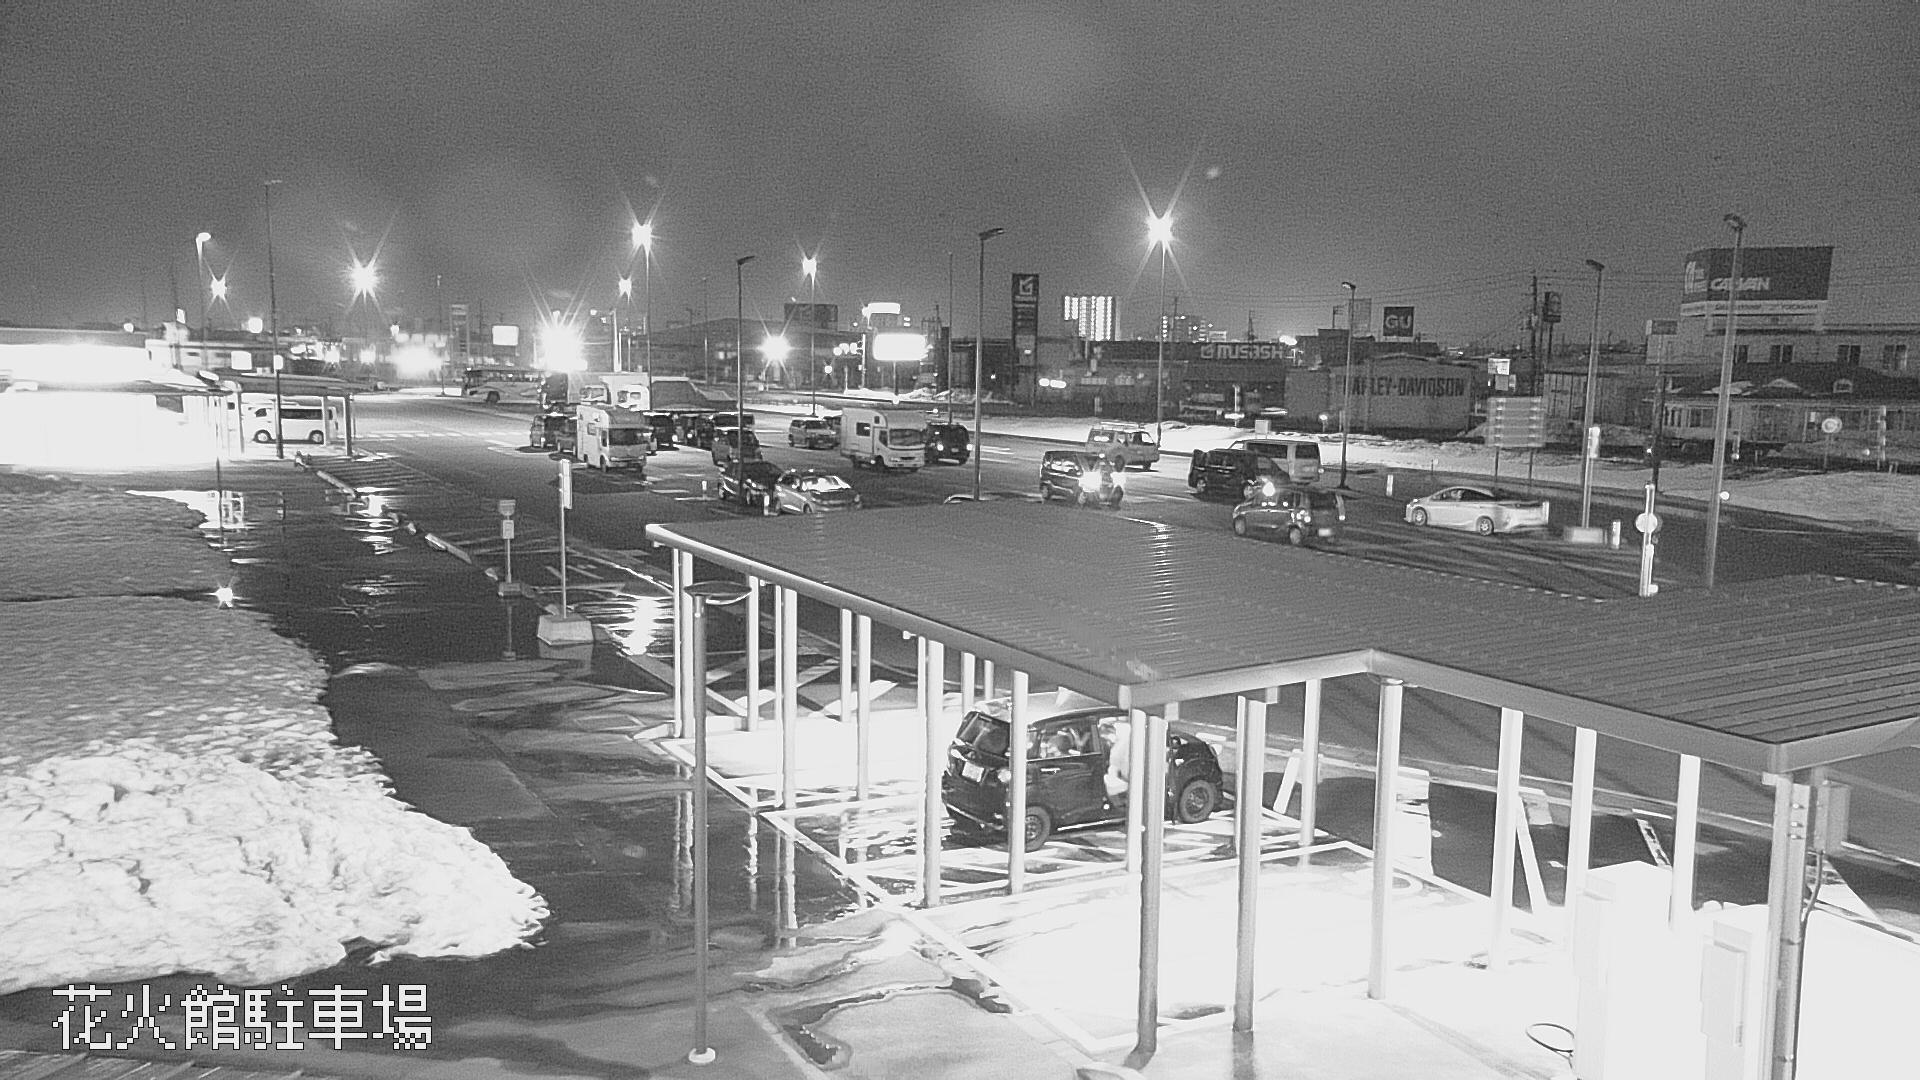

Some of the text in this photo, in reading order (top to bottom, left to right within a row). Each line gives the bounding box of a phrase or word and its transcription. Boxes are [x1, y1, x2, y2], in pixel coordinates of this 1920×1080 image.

[1710, 277, 1770, 291] CAVAN
[1385, 314, 1412, 329] GU
[1217, 344, 1287, 359] MUSASH
